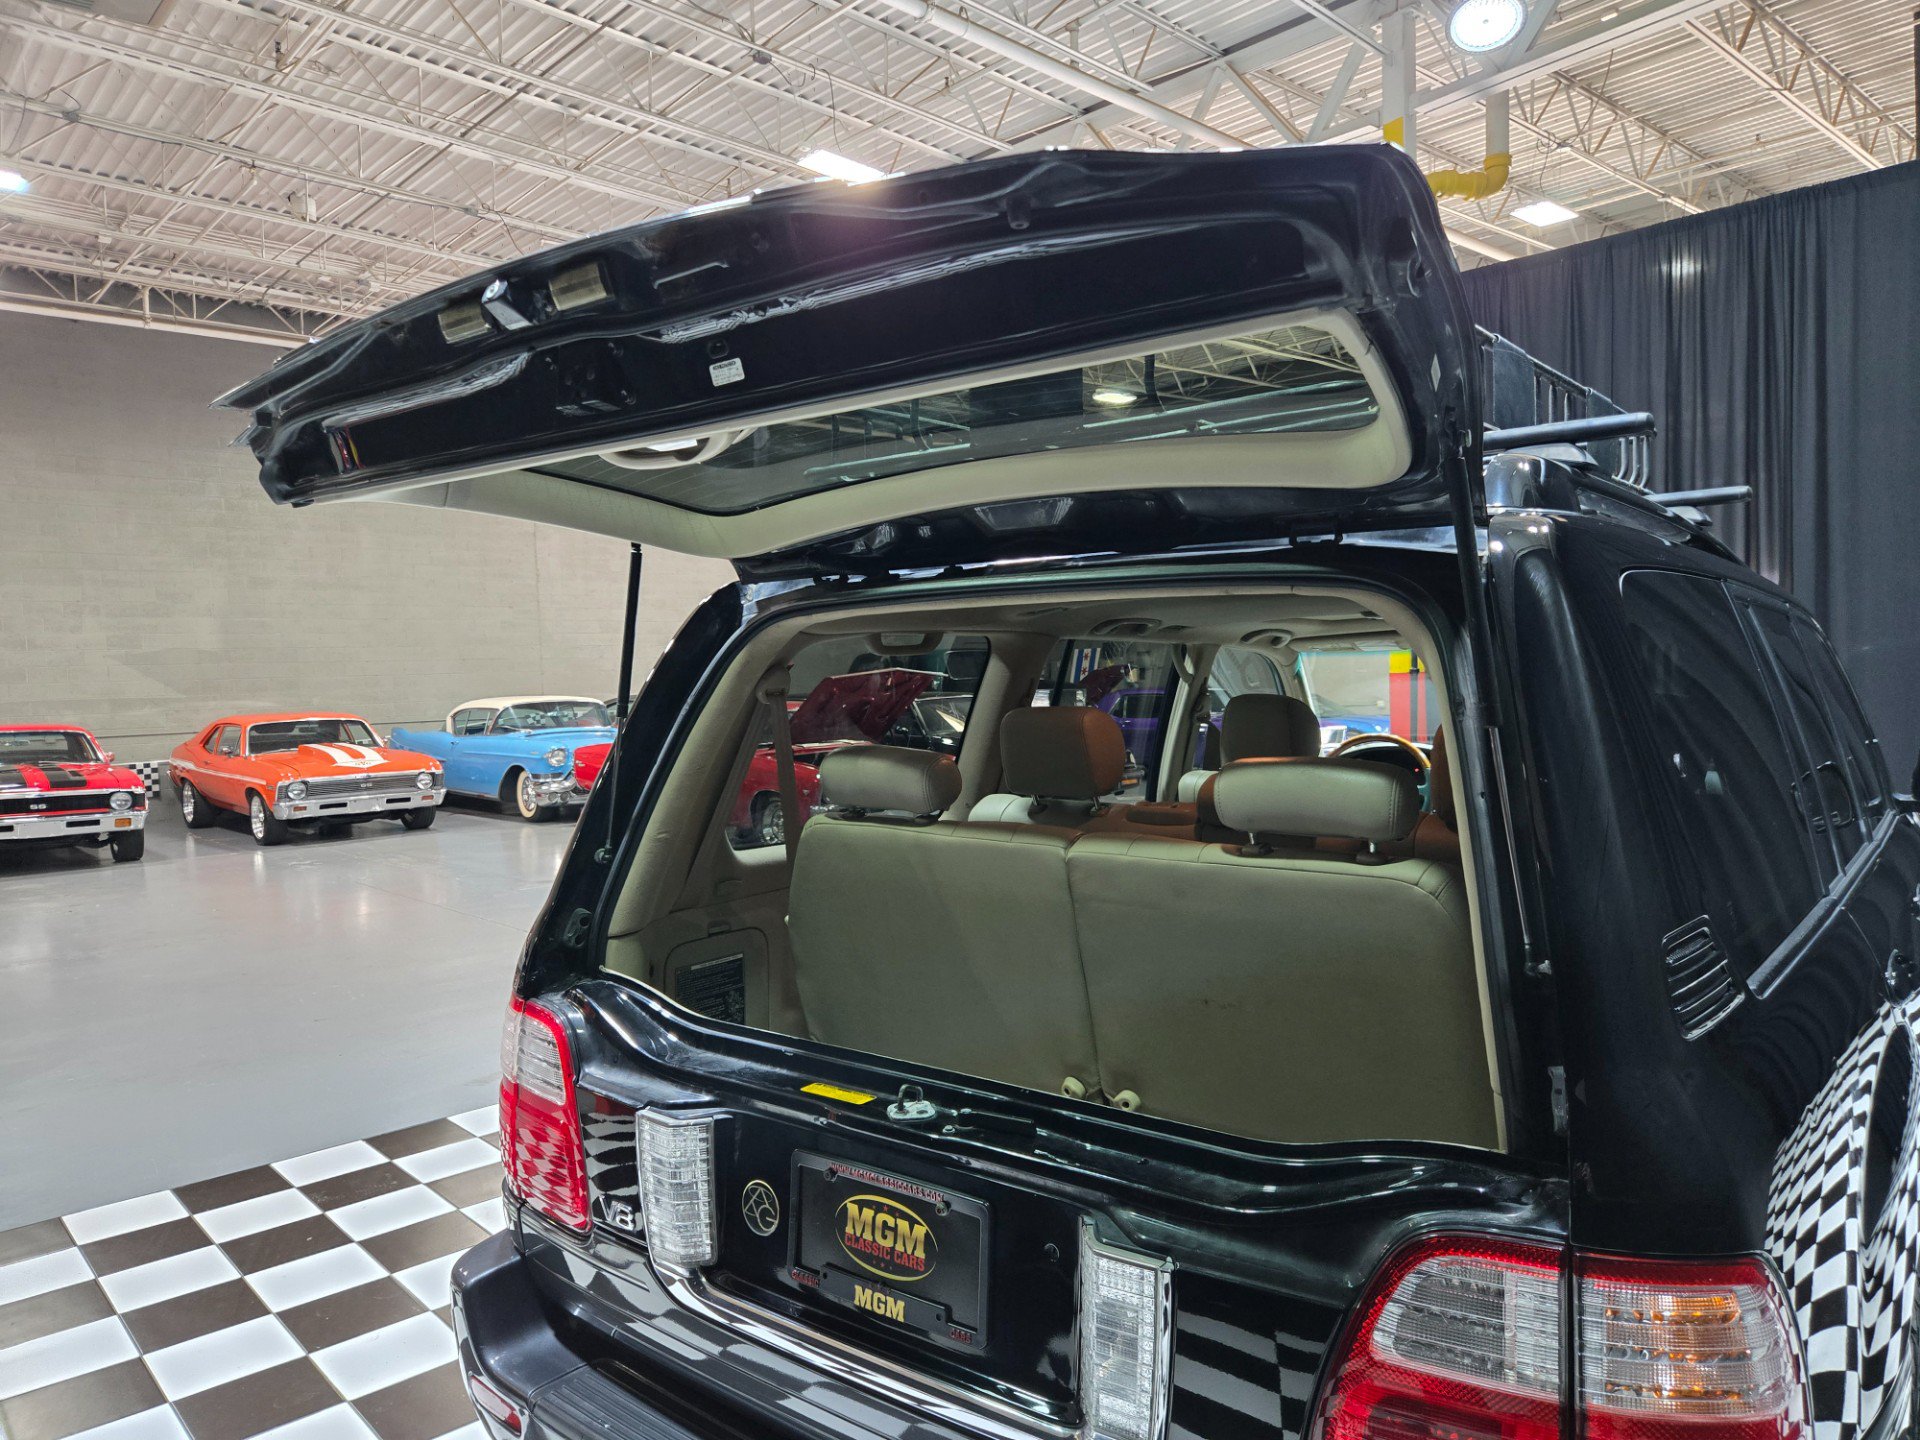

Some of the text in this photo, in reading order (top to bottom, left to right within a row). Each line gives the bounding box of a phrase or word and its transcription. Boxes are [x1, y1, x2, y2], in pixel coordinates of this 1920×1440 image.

[599, 1194, 635, 1231] V8
[845, 1202, 927, 1259] MGM
[844, 1232, 925, 1272] CLASSIC CARS
[854, 1284, 905, 1323] MGM
[949, 1328, 972, 1344] CARS
